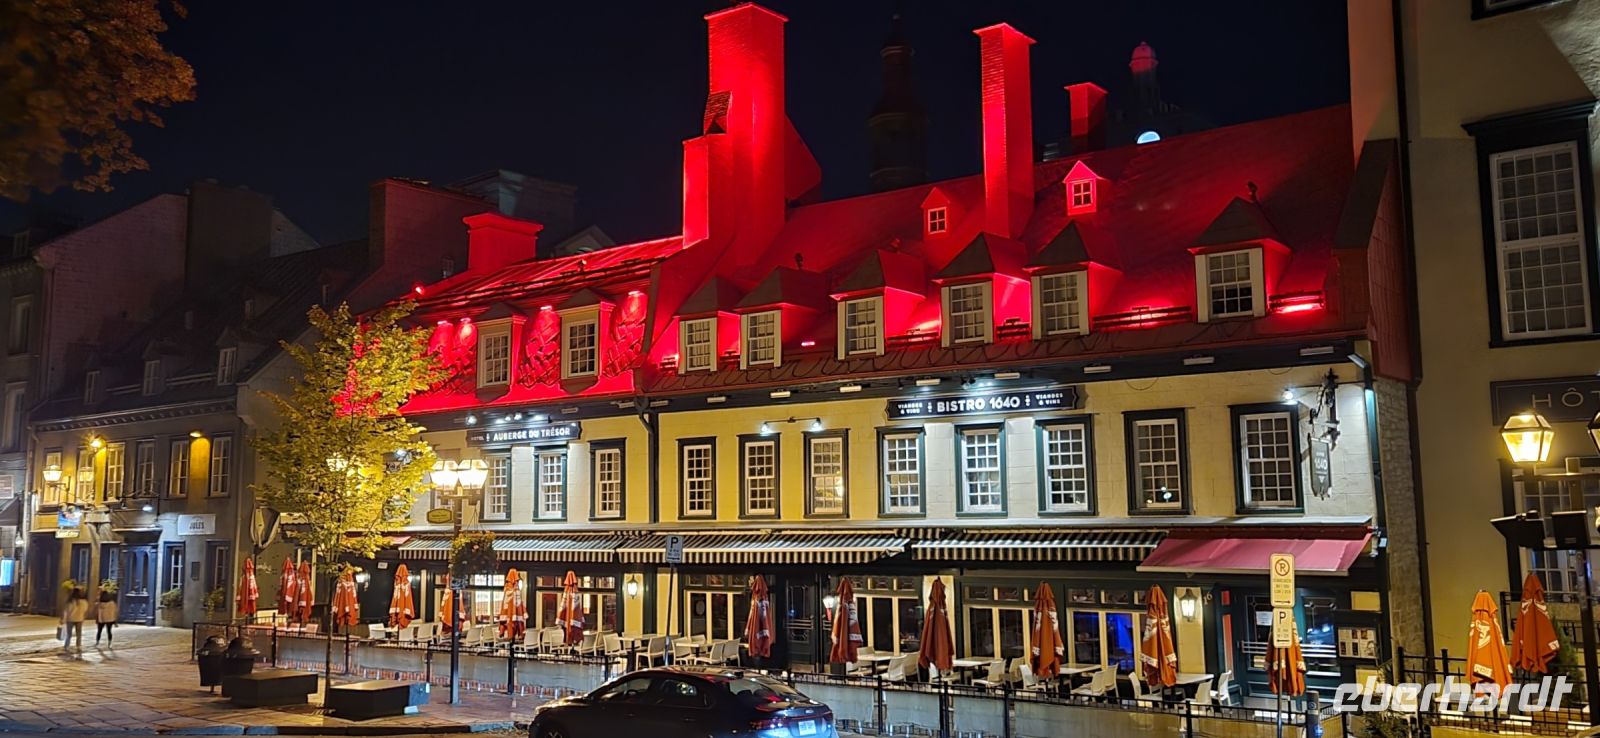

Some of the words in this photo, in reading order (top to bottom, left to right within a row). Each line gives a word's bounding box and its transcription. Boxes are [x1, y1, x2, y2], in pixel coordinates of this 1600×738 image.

[936, 398, 986, 413] BISTRO
[989, 396, 1021, 410] 1640
[493, 430, 528, 442] AUBERGE
[528, 429, 540, 439] DU
[541, 426, 571, 438] TRÉSOR
[670, 536, 679, 549] P
[1203, 592, 1213, 606] 16
[1279, 611, 1287, 625] P
